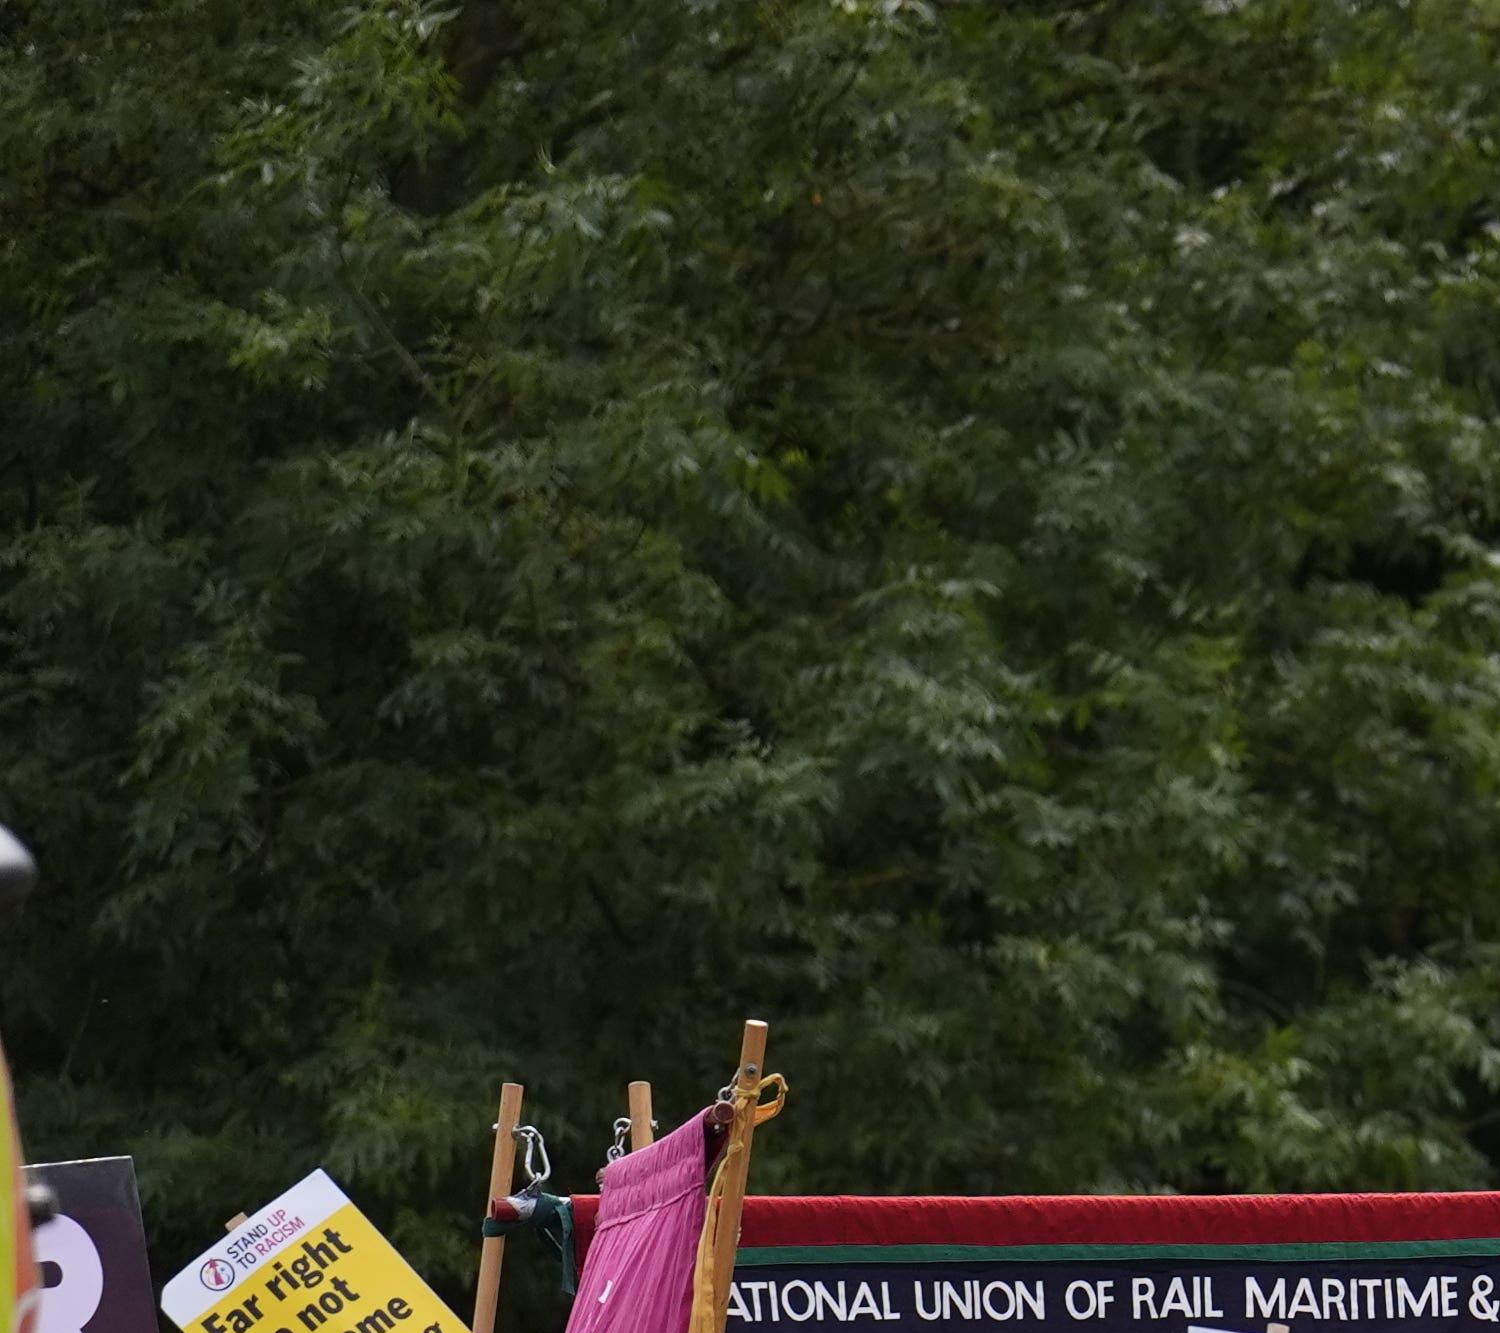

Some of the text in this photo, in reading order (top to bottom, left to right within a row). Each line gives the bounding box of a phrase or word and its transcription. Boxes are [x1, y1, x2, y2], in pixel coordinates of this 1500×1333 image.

[226, 1209, 287, 1260] STAND UP
[237, 1215, 305, 1271] TO RACISM
[265, 1227, 353, 1302] right
[296, 1276, 360, 1332] not
[725, 1278, 900, 1323] ATIONAL
[913, 1280, 1046, 1321] UNION
[1065, 1279, 1114, 1319] OF
[1132, 1276, 1224, 1319] RAIL
[1244, 1275, 1459, 1321] MARITIME
[1468, 1274, 1500, 1322] &
